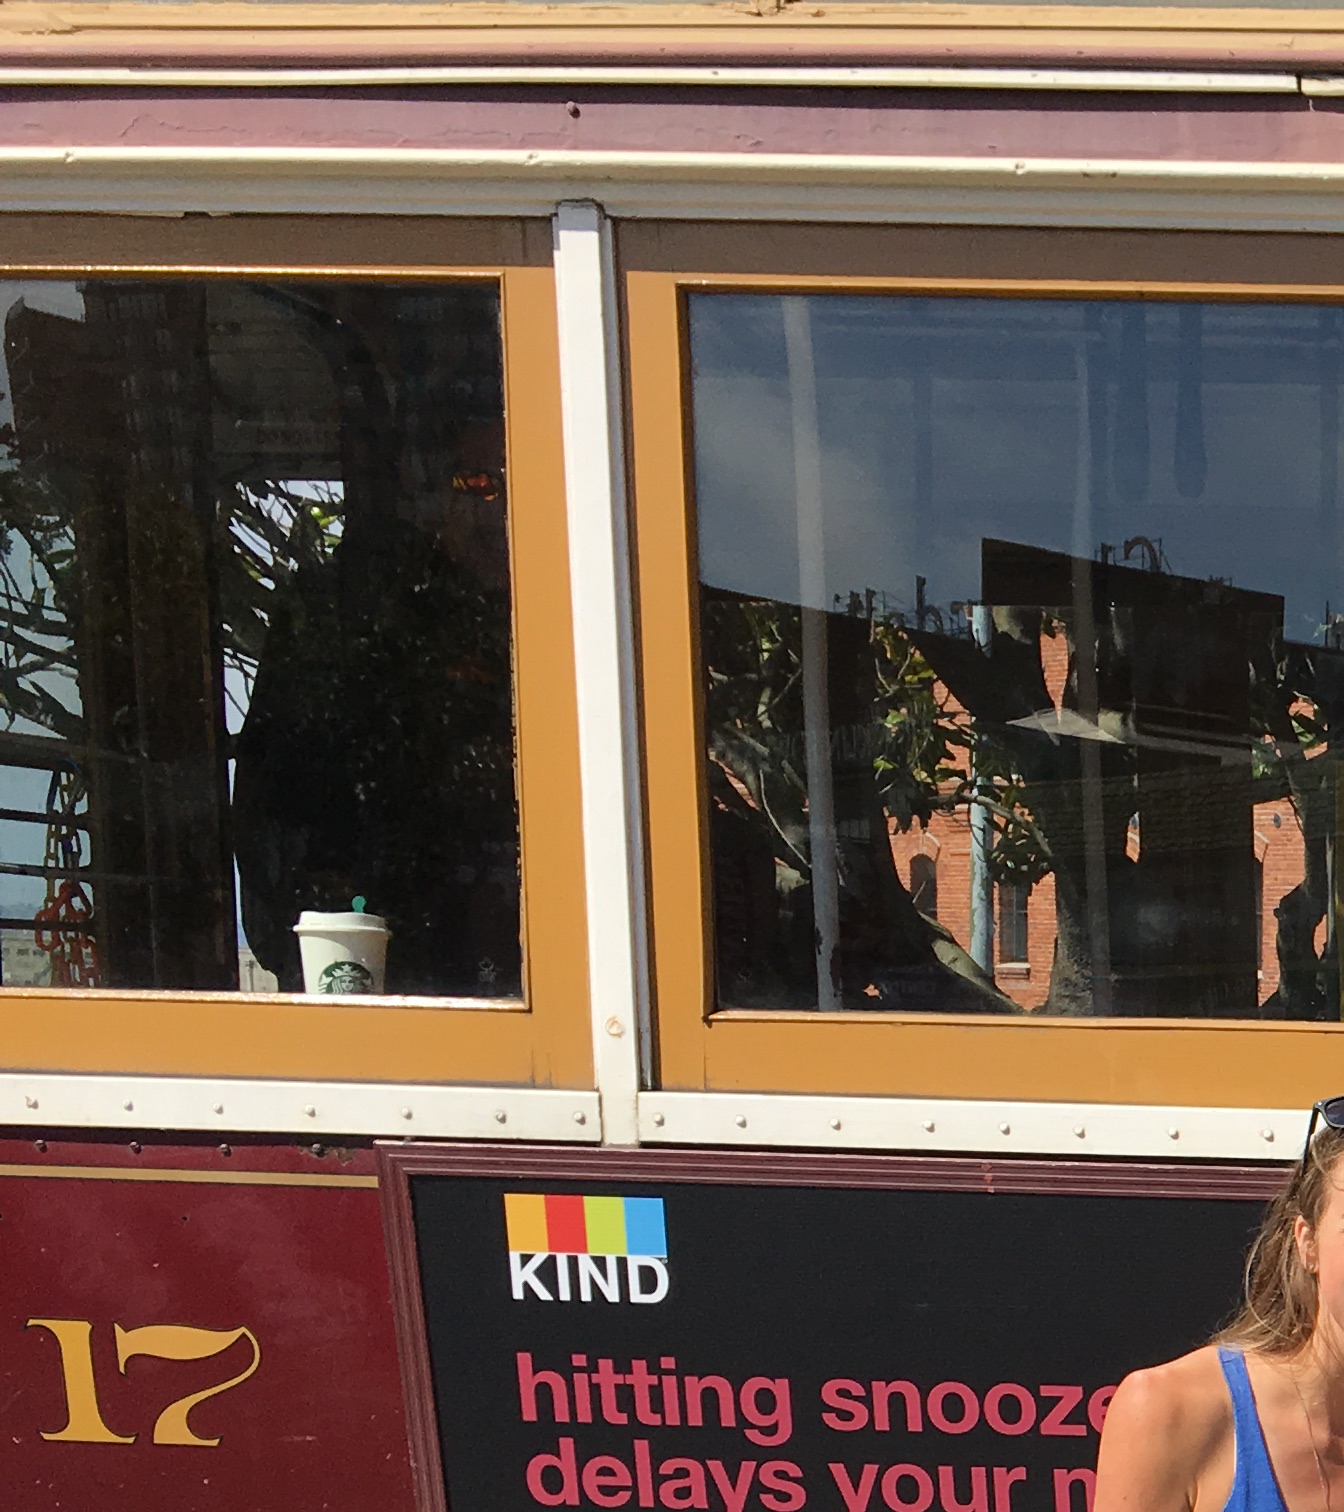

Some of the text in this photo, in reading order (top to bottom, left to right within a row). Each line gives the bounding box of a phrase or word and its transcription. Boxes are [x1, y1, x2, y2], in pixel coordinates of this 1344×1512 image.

[510, 1253, 669, 1304] KIND
[25, 1317, 261, 1447] 17
[516, 1351, 792, 1447] hitting
